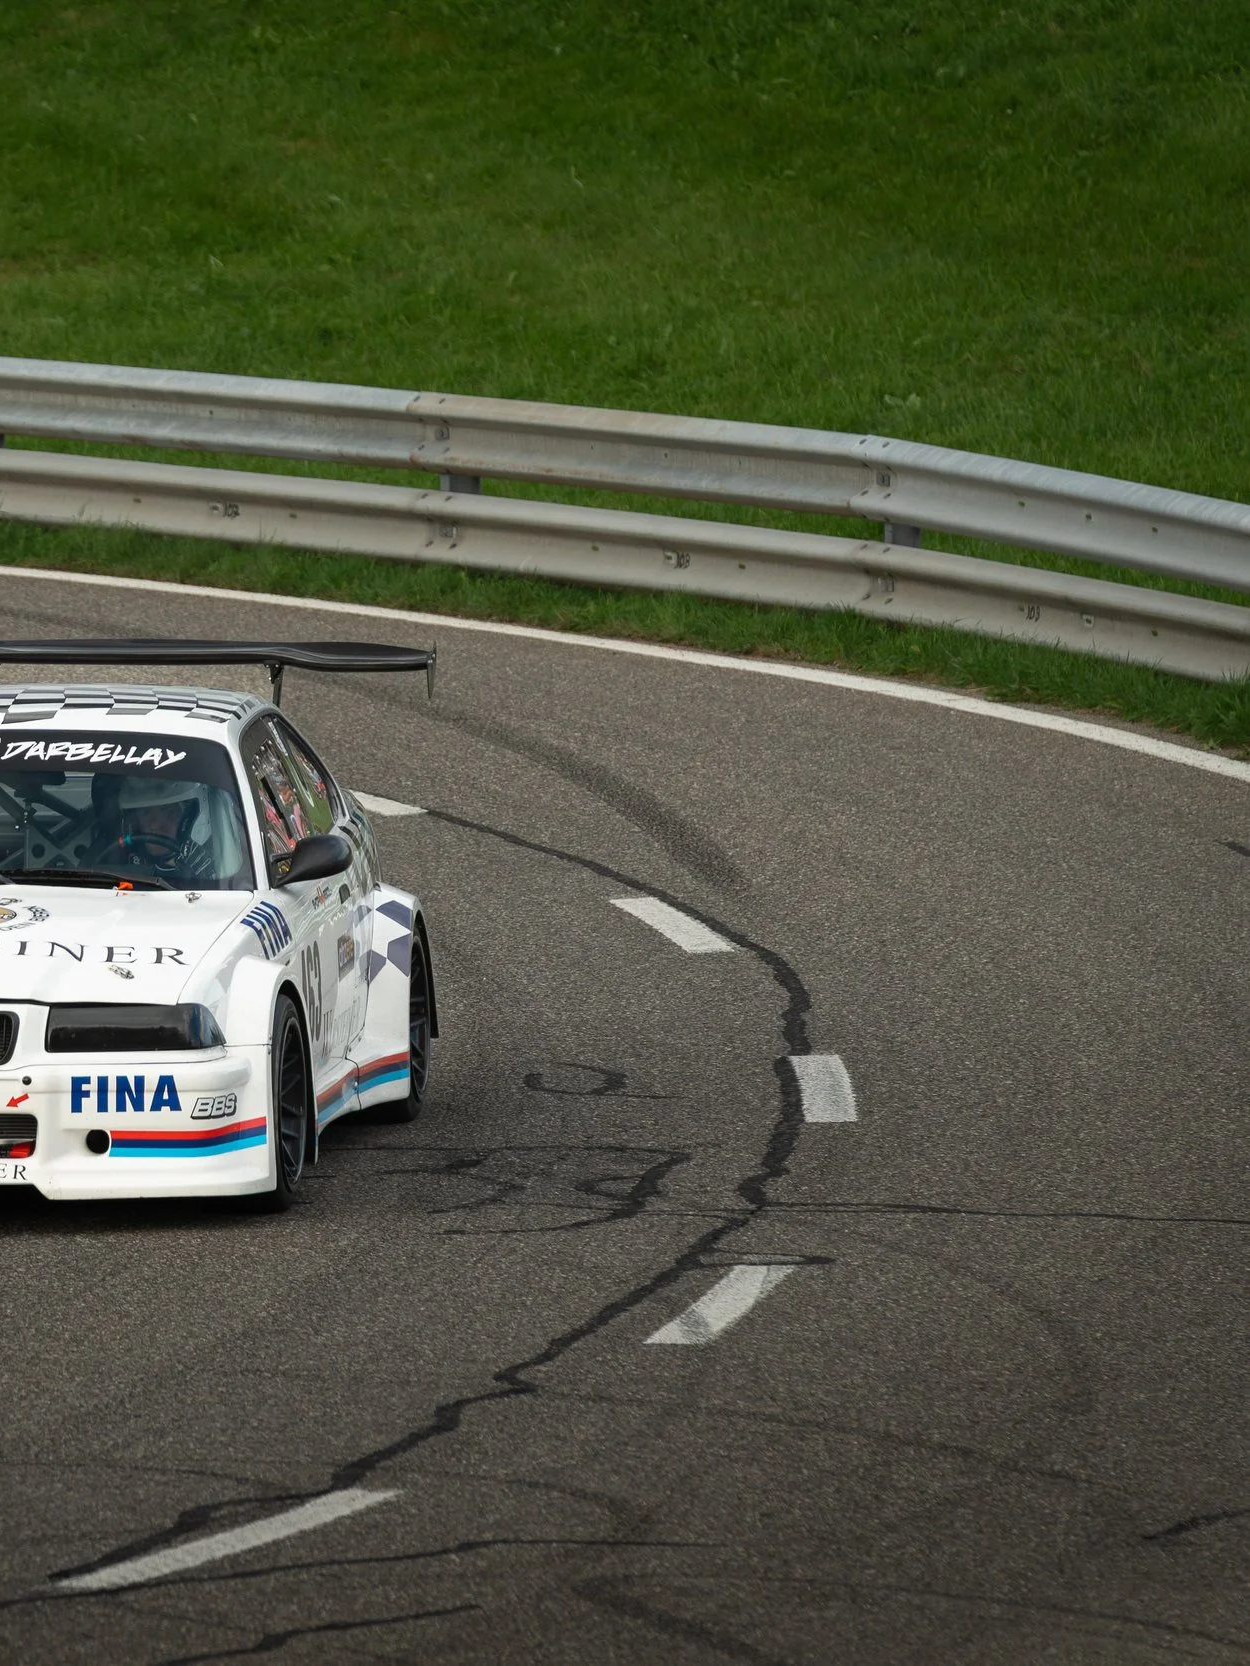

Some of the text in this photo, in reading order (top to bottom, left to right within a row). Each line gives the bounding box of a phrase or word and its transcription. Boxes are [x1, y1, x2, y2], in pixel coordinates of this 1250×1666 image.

[1, 741, 187, 769] DARBELLAY
[301, 940, 323, 1043] 63
[71, 1075, 182, 1113] FINA
[190, 1093, 238, 1120] BBS
